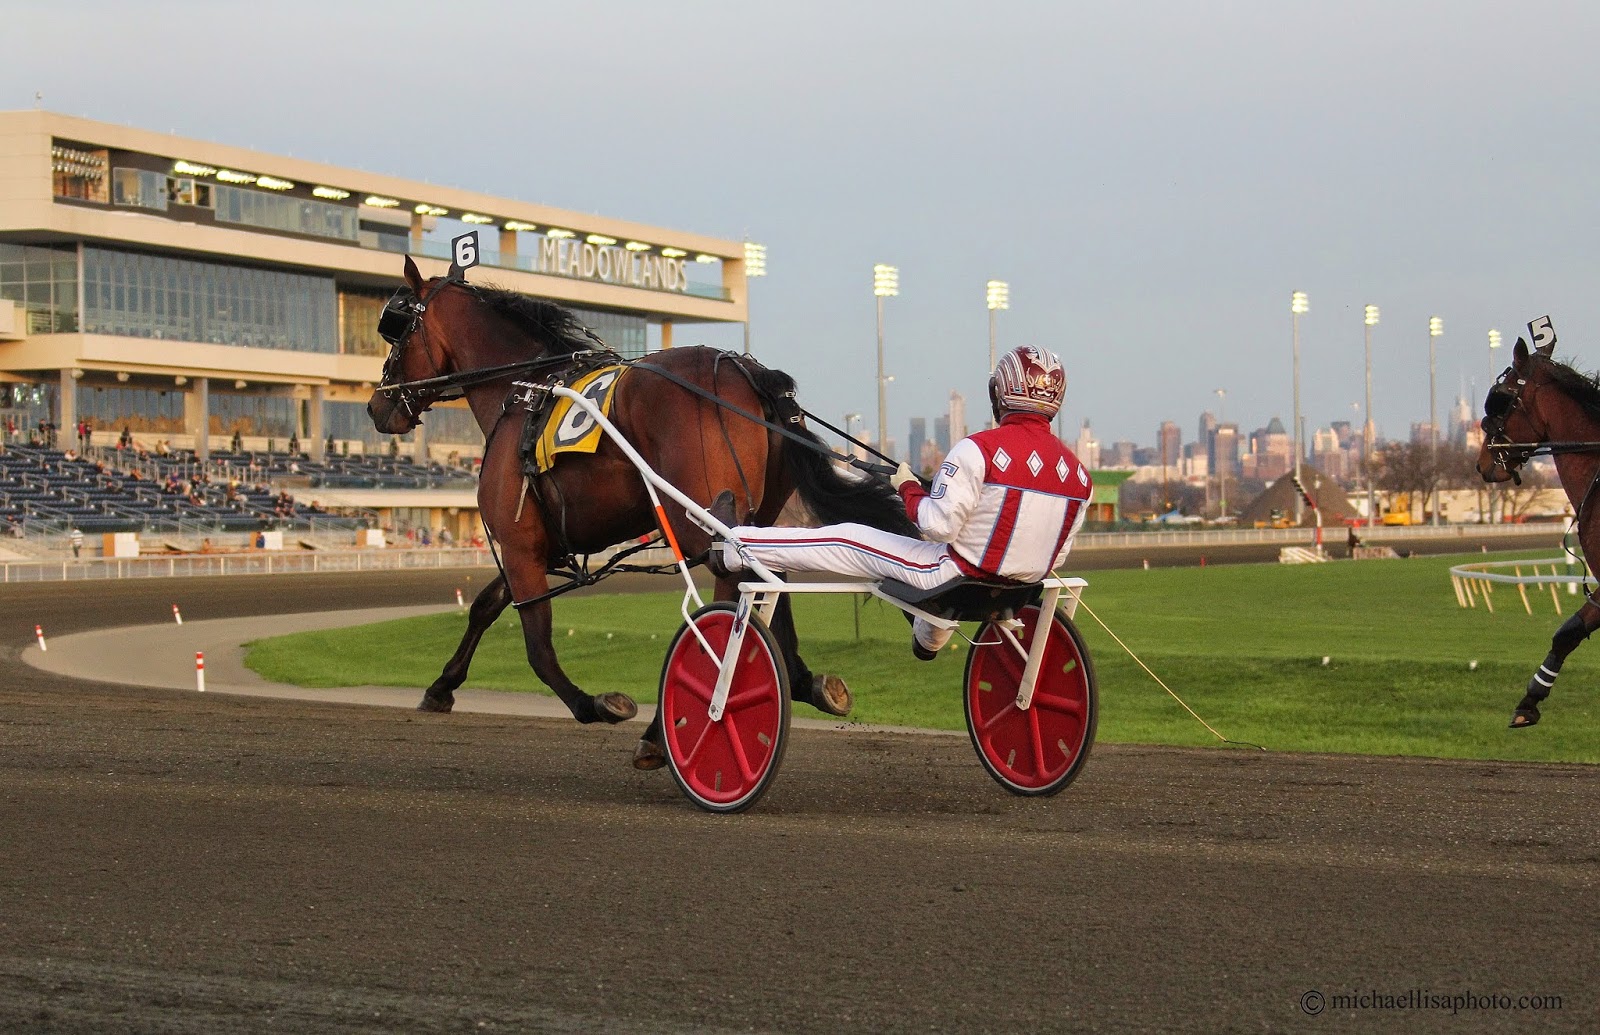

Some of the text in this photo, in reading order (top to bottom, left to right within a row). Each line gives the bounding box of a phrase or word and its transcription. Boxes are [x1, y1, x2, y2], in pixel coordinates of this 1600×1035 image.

[456, 236, 475, 267] 6
[541, 237, 687, 291] MEADOWLANDS
[1531, 316, 1554, 348] 5
[556, 370, 618, 444] 6
